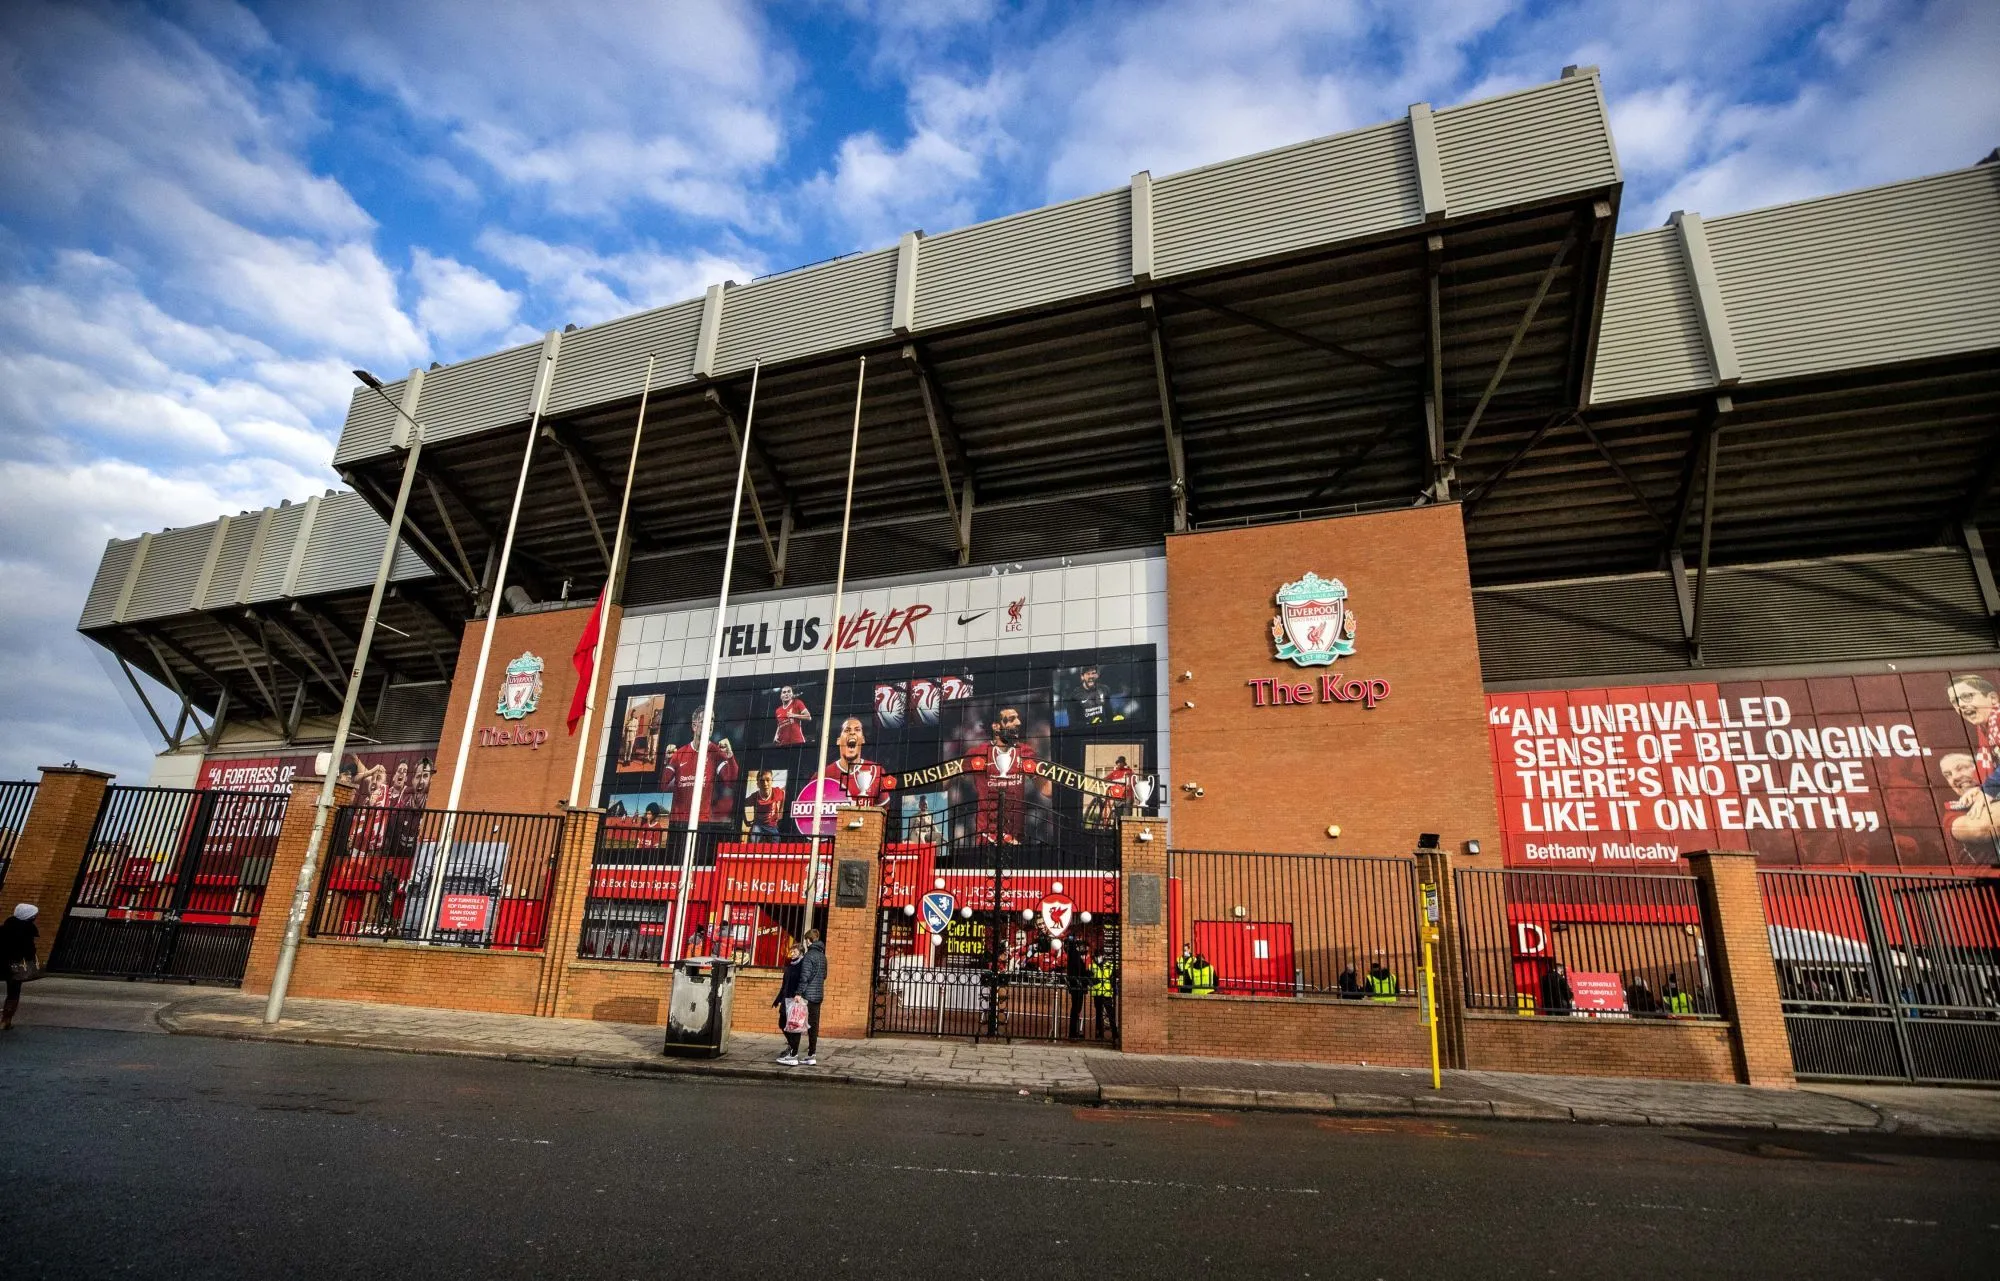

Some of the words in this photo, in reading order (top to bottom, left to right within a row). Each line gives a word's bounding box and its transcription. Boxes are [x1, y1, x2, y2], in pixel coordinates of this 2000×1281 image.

[1288, 606, 1337, 617] LIVERPOOL
[720, 622, 771, 657] TELL
[783, 617, 820, 652] US
[823, 604, 932, 651] NEVER
[1248, 677, 1314, 706] The
[1320, 673, 1391, 708] Kop
[1568, 696, 1791, 735] UNRIVALLED
[479, 726, 511, 747] The
[512, 723, 548, 750] Kop
[1513, 736, 1627, 768] SENSE
[1637, 734, 1683, 764] OF
[1693, 724, 1932, 762] BELONGING.
[222, 766, 278, 784] FORTRESS
[280, 765, 296, 782] OF
[903, 758, 965, 787] PAISLEY
[1036, 761, 1110, 796] GATEWAY
[1516, 767, 1663, 800] THERE’S
[1673, 765, 1726, 796] NO
[1736, 761, 1869, 795] PLACE
[1522, 801, 1600, 832] LIKE
[1608, 800, 1640, 831] IT
[1653, 799, 1708, 831] ON
[1526, 843, 1597, 862] Bethany
[1602, 842, 1679, 862] Mulcahy
[727, 877, 748, 892] The
[751, 878, 775, 895] Kop
[780, 879, 800, 892] Bar
[893, 881, 915, 896] Bar
[947, 920, 970, 937] Get
[973, 920, 986, 937] in
[1518, 923, 1547, 953] D
